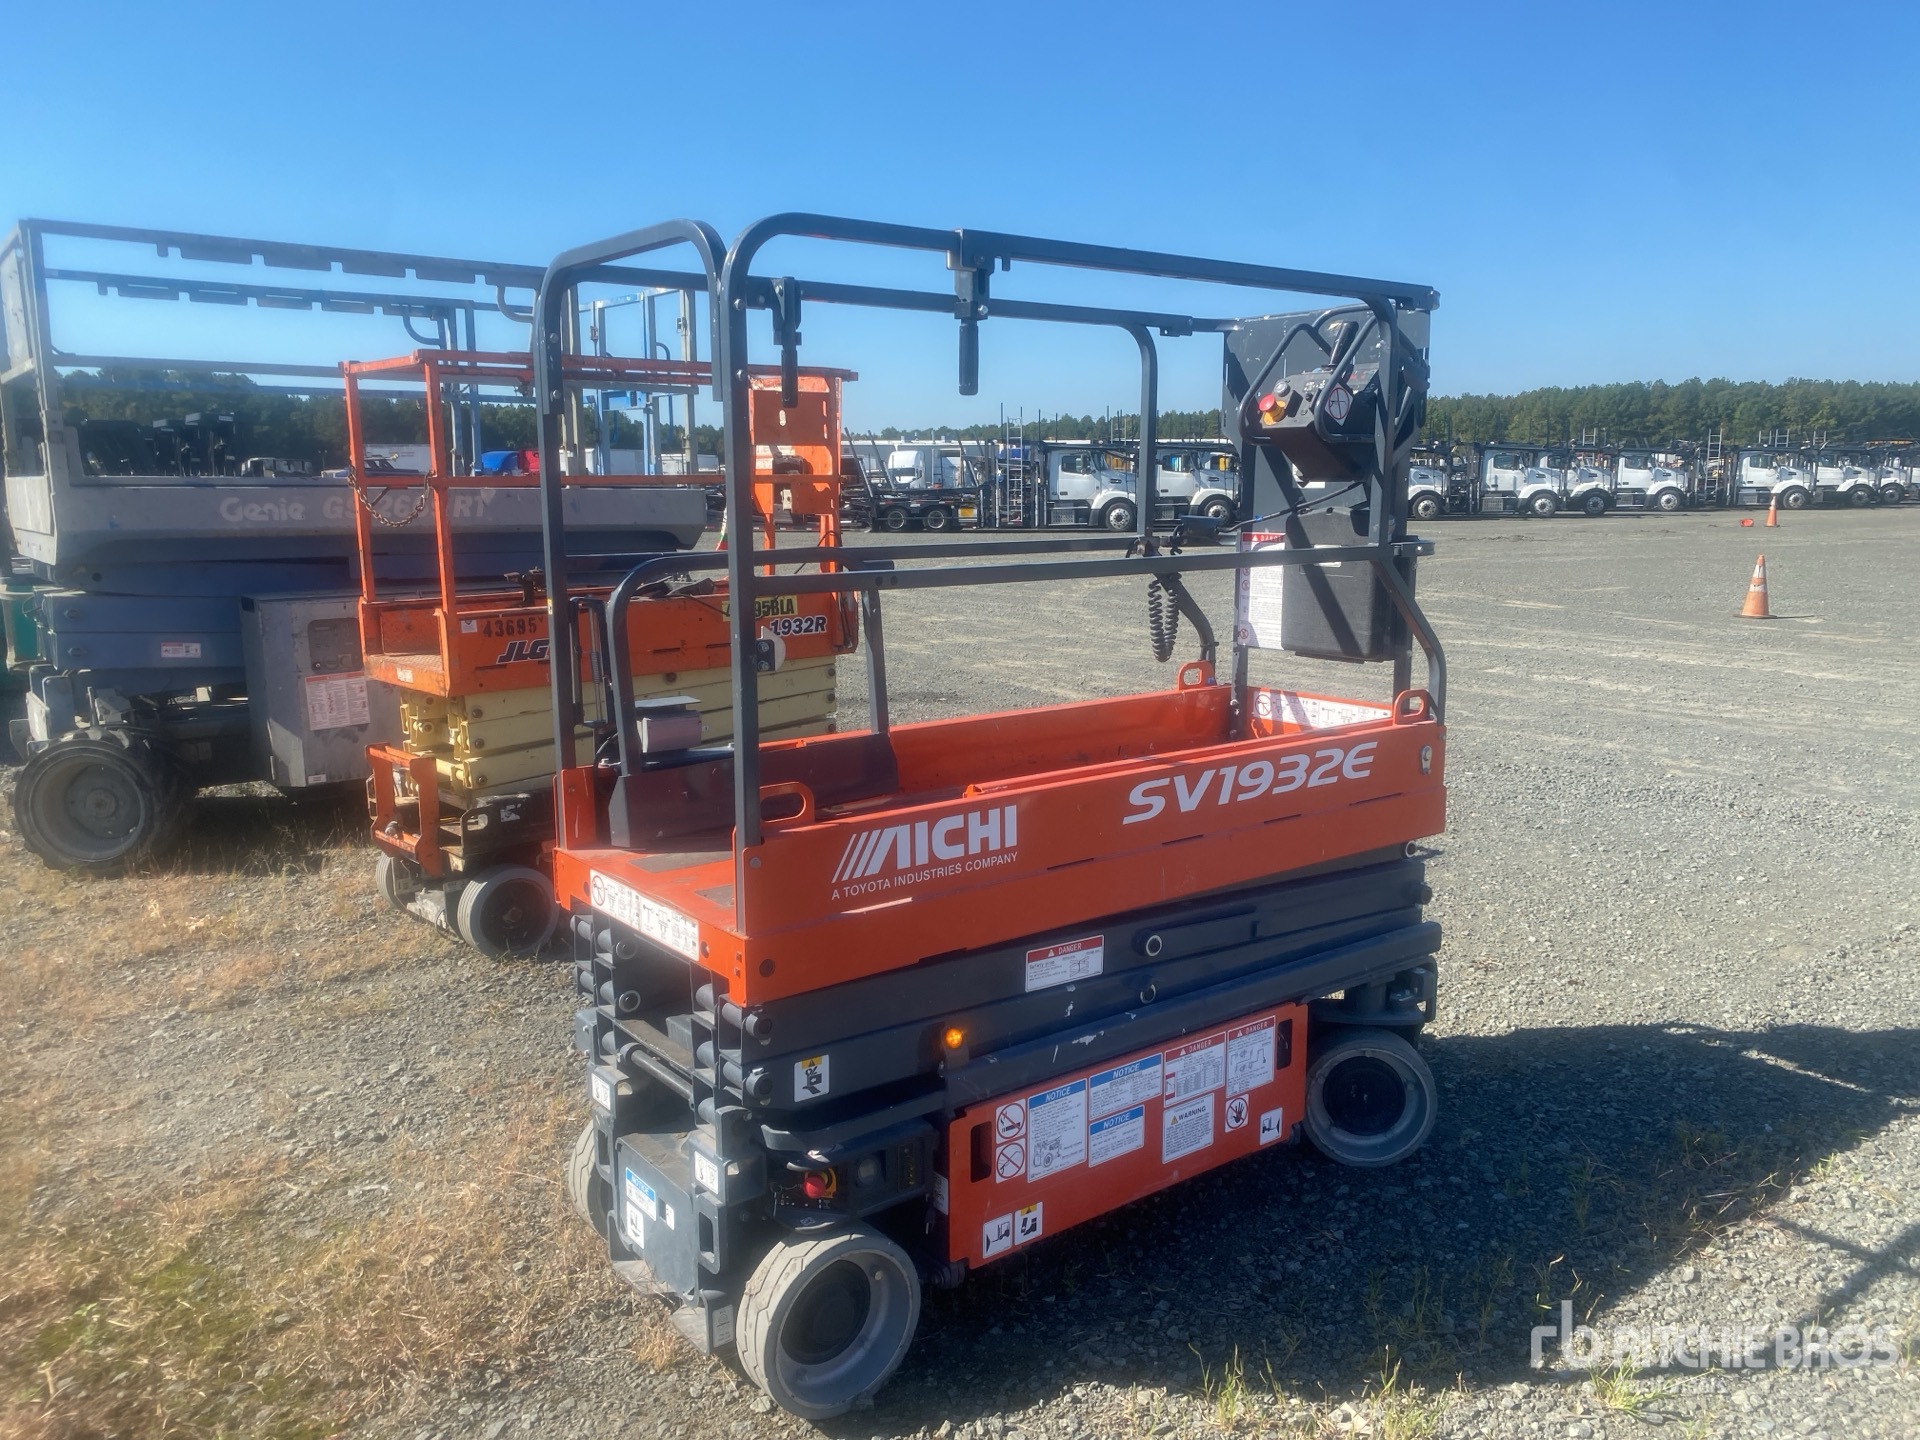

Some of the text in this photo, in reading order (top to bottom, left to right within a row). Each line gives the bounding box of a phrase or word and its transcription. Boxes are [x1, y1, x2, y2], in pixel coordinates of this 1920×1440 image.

[220, 497, 305, 521] Genie
[482, 617, 537, 638] 43695
[769, 615, 827, 636] 1932R
[496, 638, 550, 664] JLG
[1122, 741, 1378, 825] SV1932E
[830, 804, 1018, 884] AICHI
[831, 851, 1018, 900] A TOYOTA INDUSTRIES COMPANY
[1058, 942, 1082, 955] DANGER
[1113, 1063, 1140, 1079] NOTICE
[1045, 1086, 1071, 1102] NOTICE
[1103, 1113, 1131, 1129] NOTICE
[1178, 1106, 1206, 1121] WARNING
